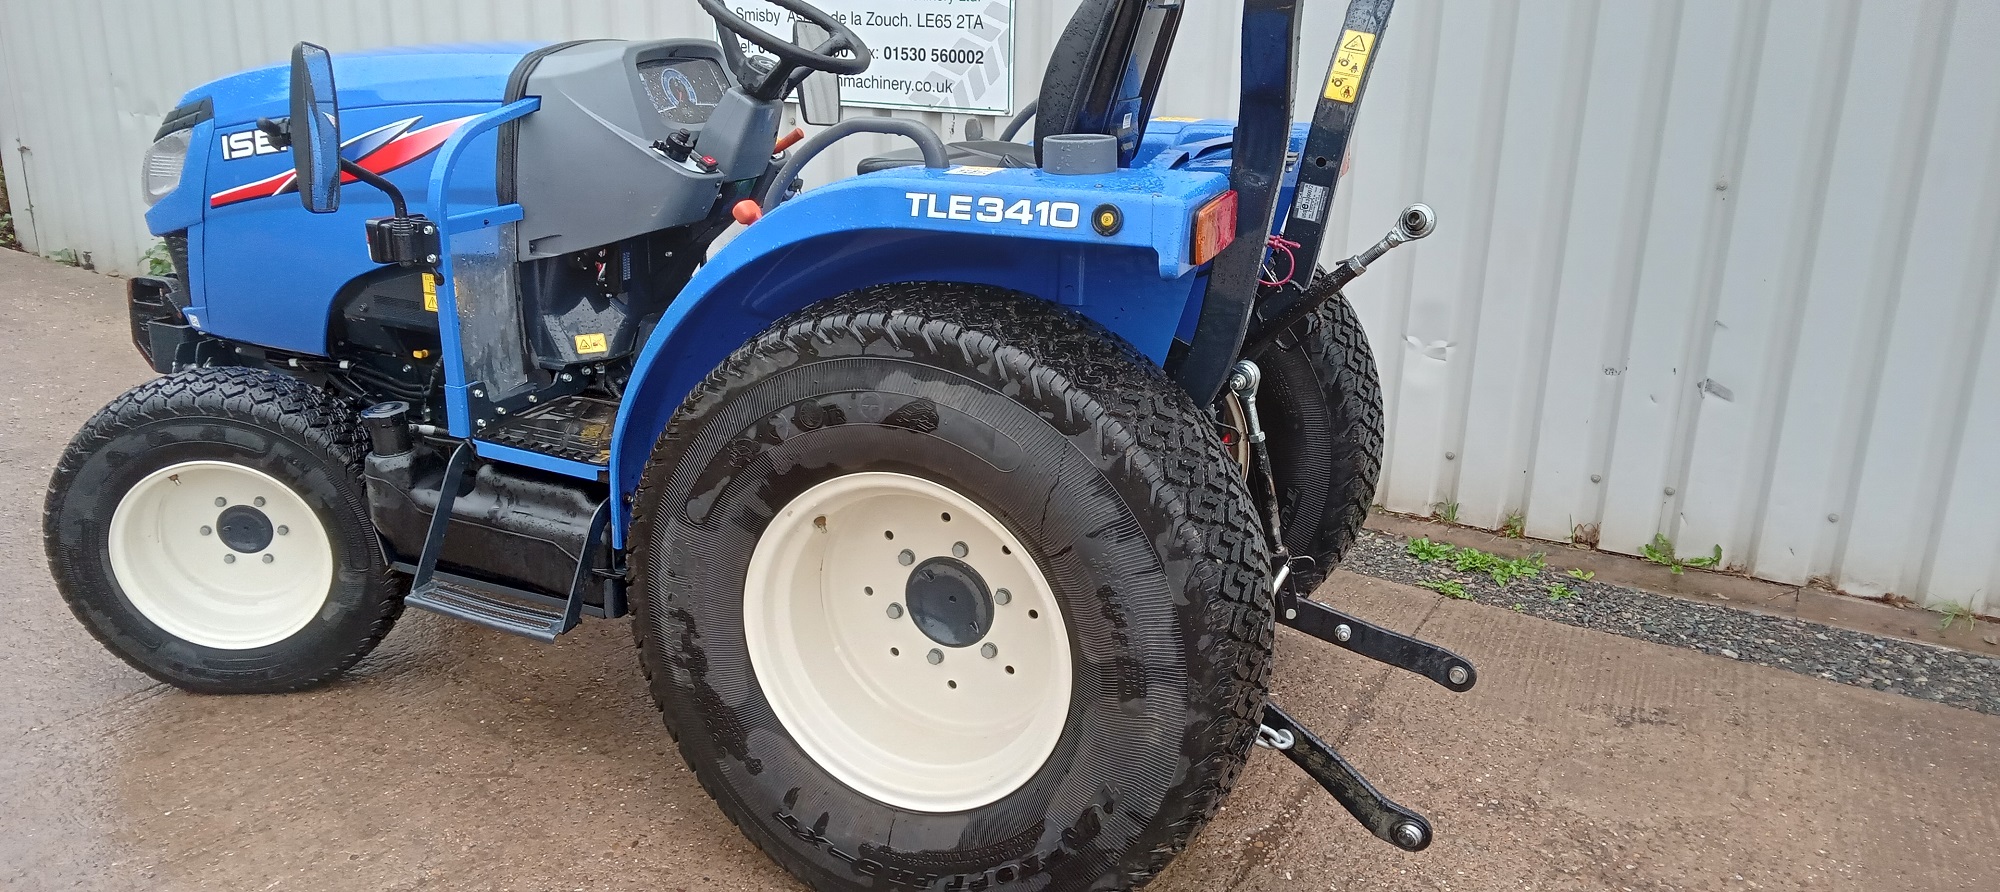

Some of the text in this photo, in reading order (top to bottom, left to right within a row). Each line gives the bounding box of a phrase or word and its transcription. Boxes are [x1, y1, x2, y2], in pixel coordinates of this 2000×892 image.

[736, 7, 780, 26] Smisby
[851, 11, 862, 26] la
[866, 12, 912, 28] Zouch.
[917, 13, 951, 29] LE65
[956, 14, 984, 30] 2TA
[740, 40, 754, 53] el:
[884, 46, 926, 62] 01530
[931, 48, 984, 64] 560002
[221, 128, 289, 160] ISE
[905, 191, 1080, 228] TLE3410
